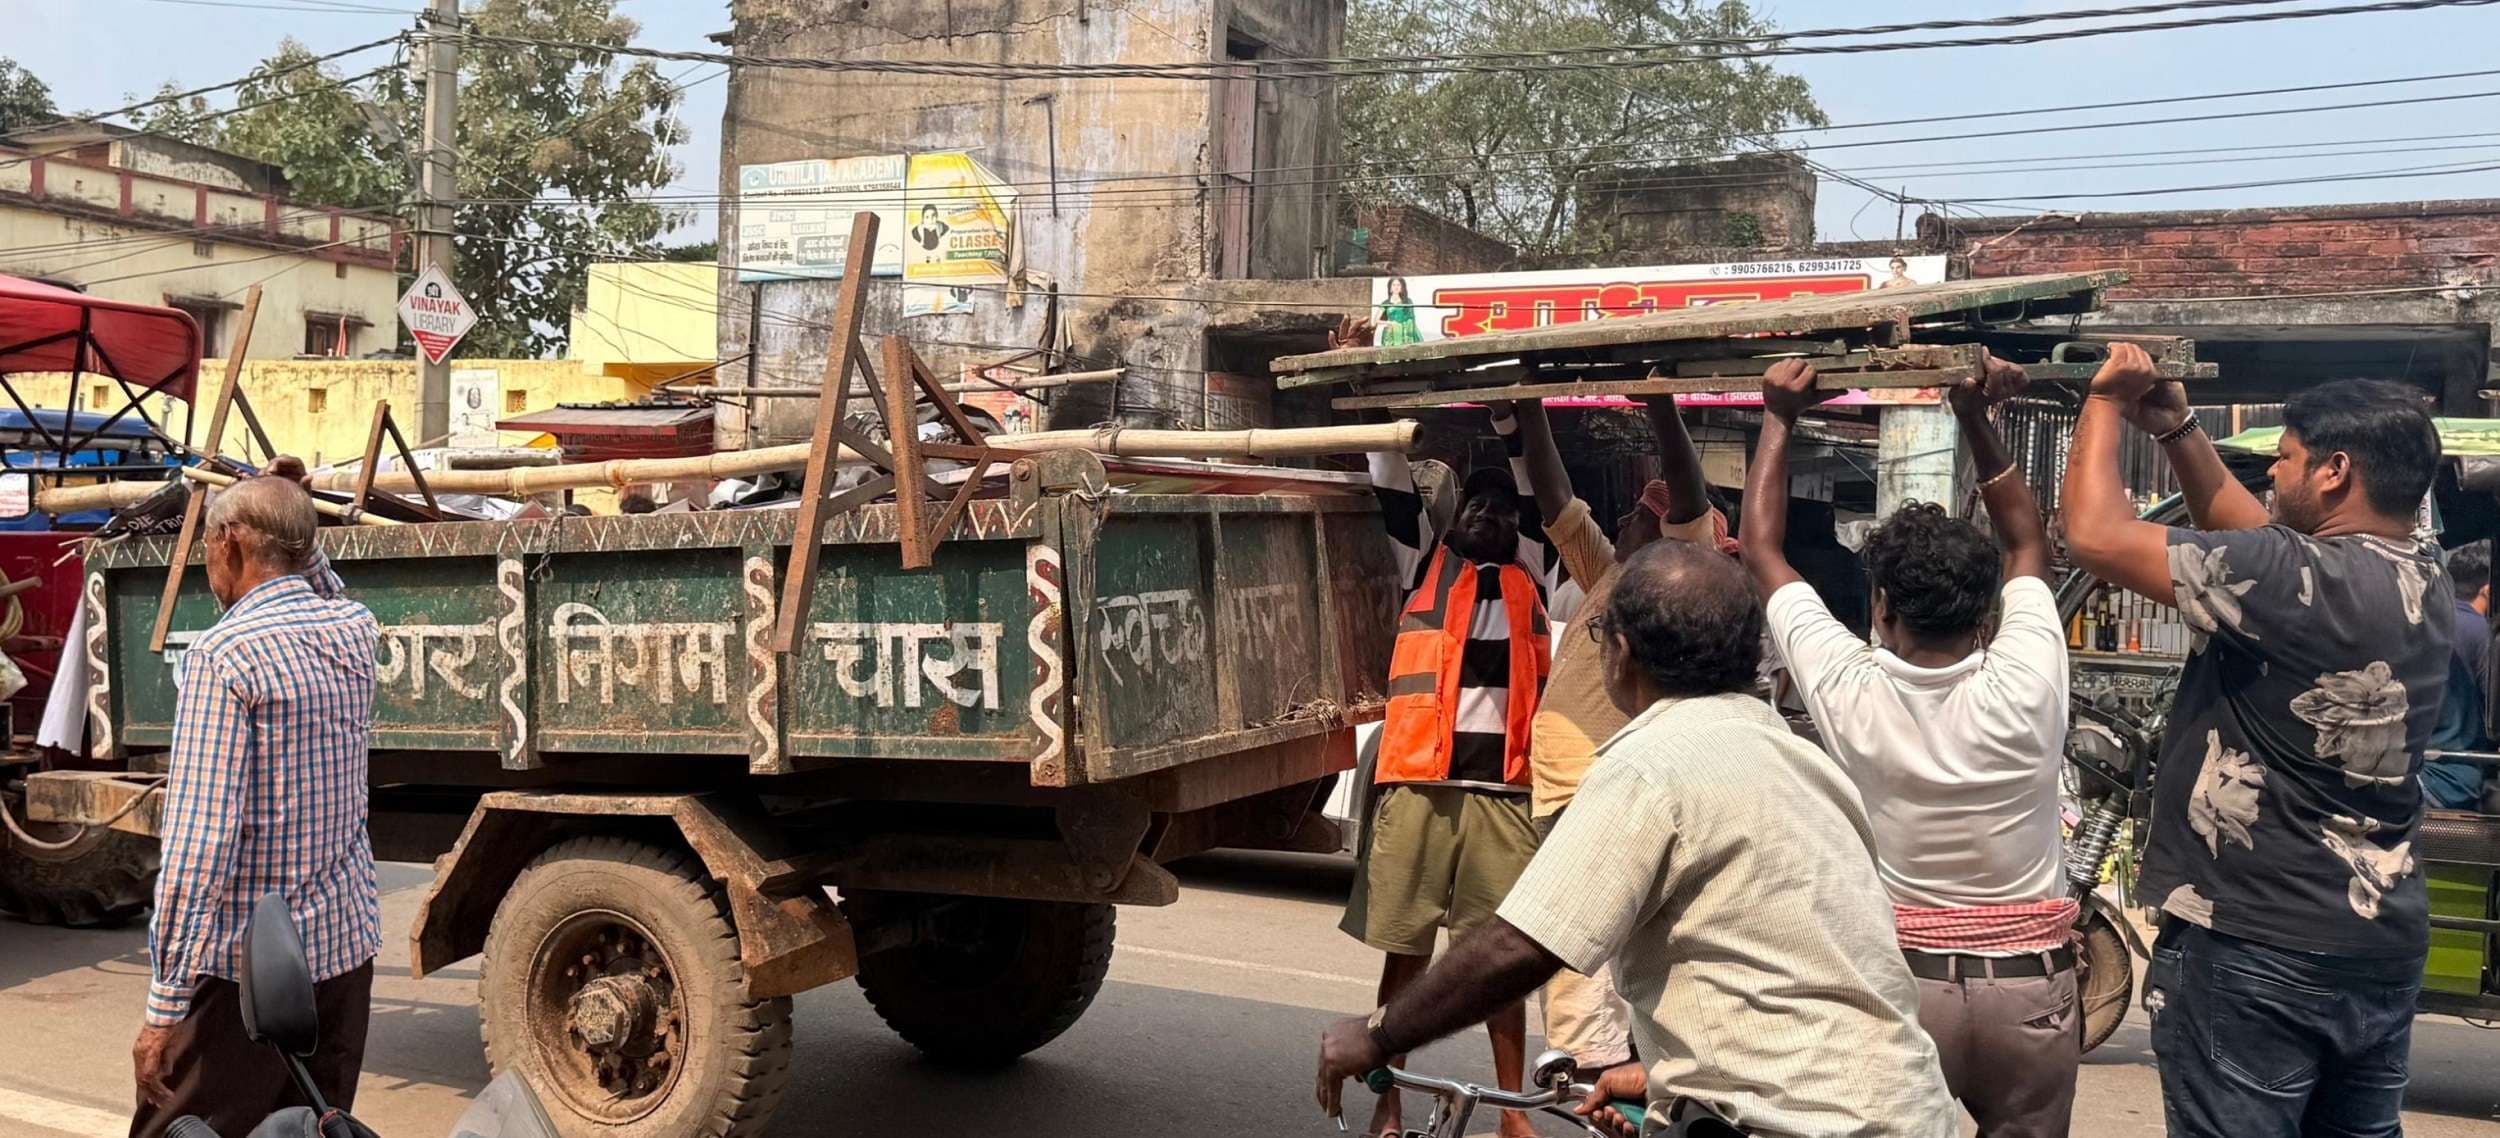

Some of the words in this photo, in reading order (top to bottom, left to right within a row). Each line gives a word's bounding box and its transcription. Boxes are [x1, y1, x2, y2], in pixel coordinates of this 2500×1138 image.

[843, 155, 905, 182] ACADEMY
[1731, 263, 1796, 275] 9905766216,
[1798, 260, 1862, 272] 6299341725
[410, 295, 461, 316] VINAYAK
[414, 312, 456, 333] LIBRARY
[1096, 588, 1206, 687] स्वच्छ
[375, 618, 497, 700] गर
[548, 602, 735, 704] निगम
[814, 621, 1003, 710] चास
